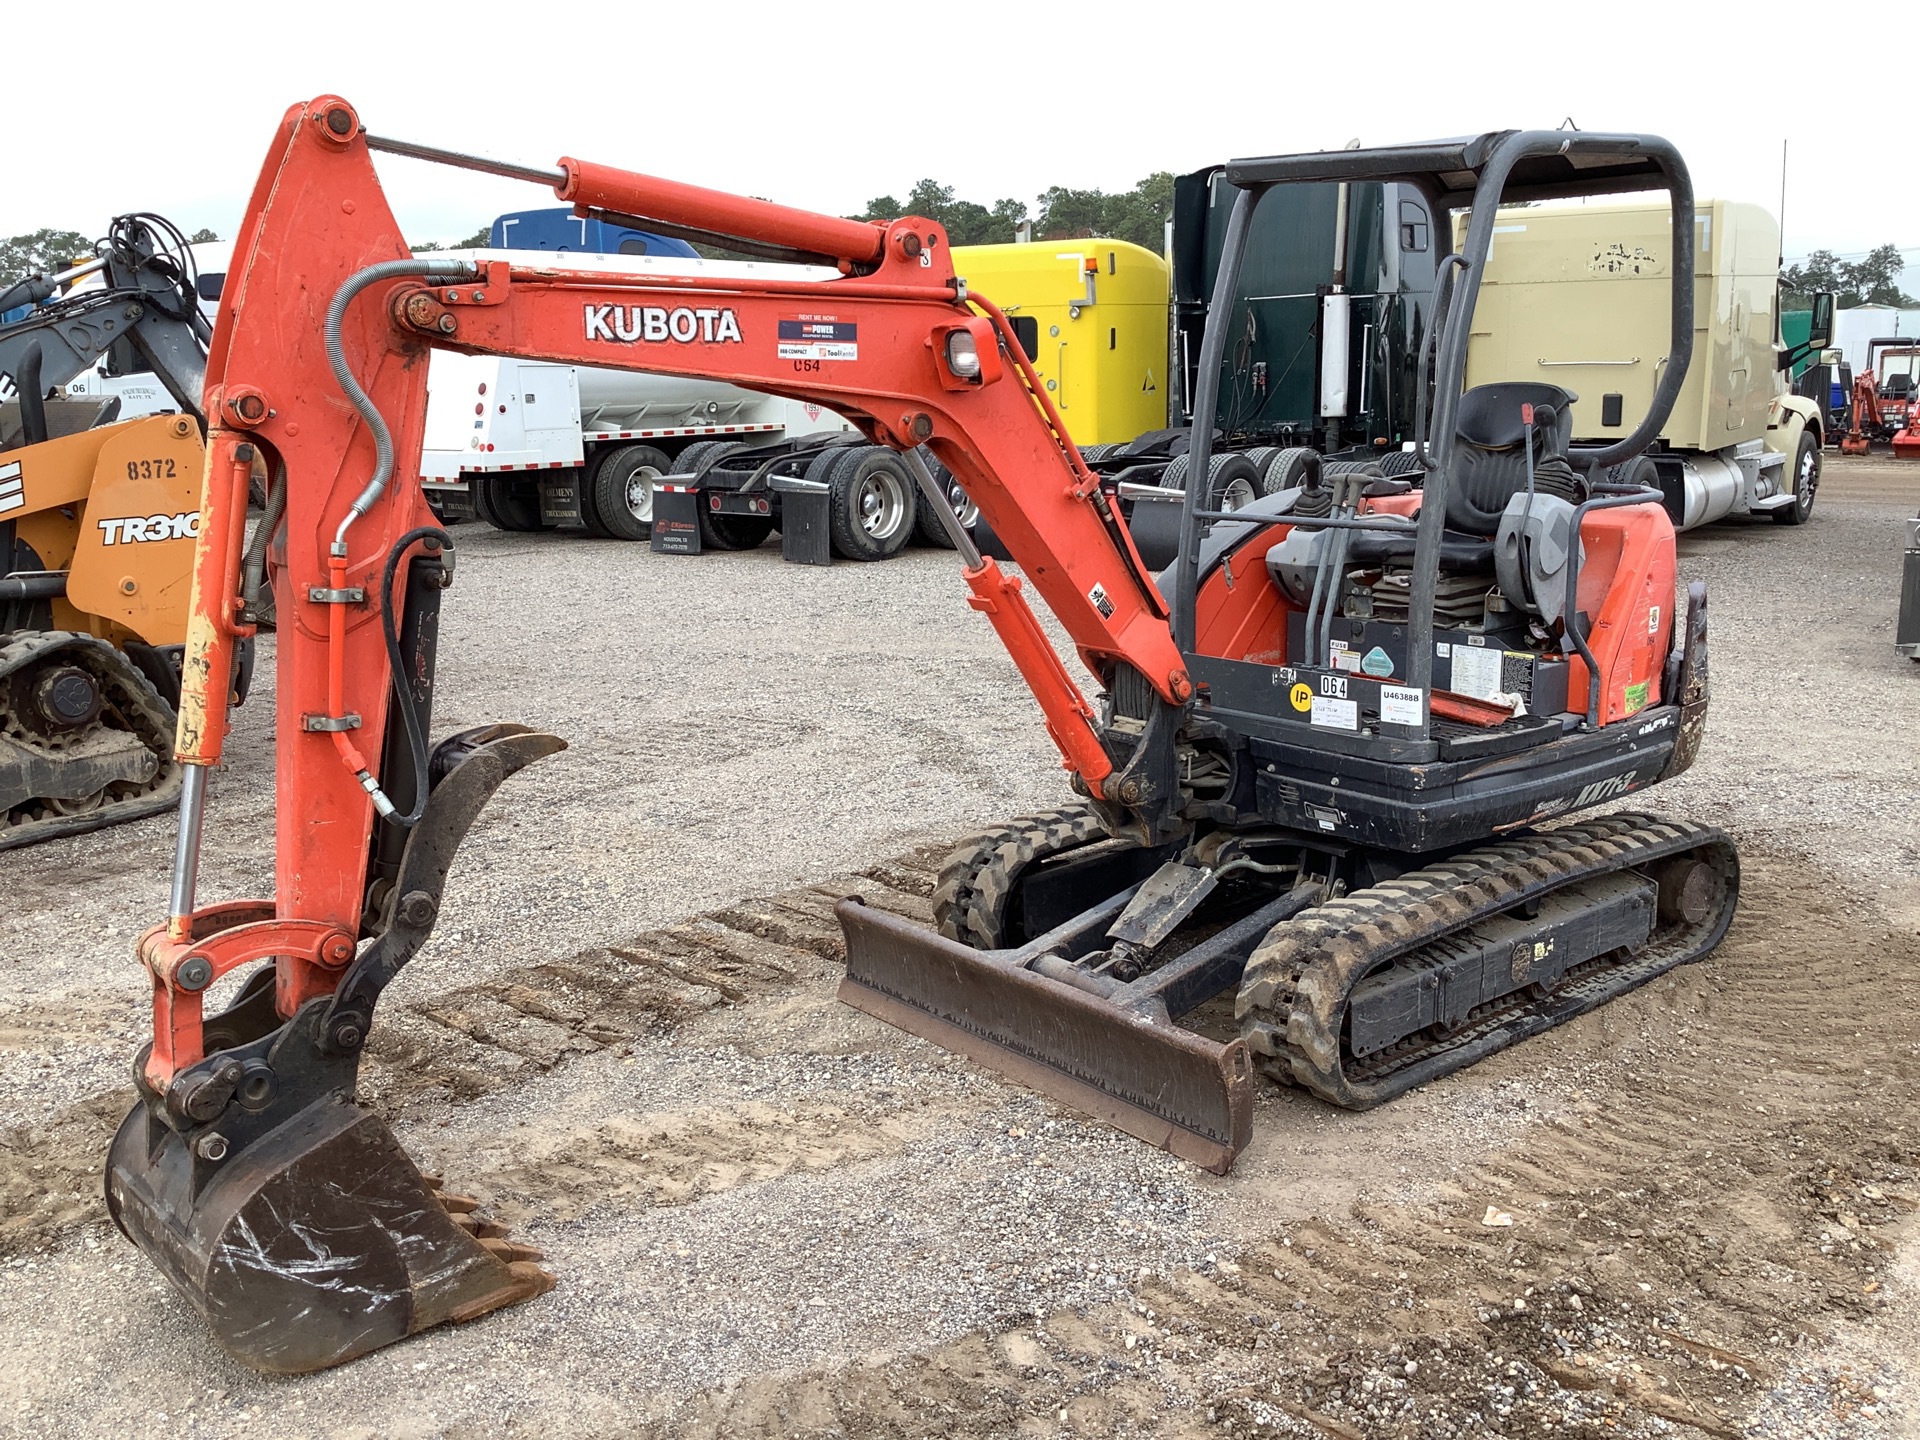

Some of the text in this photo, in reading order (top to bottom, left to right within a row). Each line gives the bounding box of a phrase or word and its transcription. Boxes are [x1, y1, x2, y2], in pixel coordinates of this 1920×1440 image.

[584, 304, 744, 343] KUBOTA
[812, 325, 834, 334] POWER
[72, 384, 86, 393] 06
[127, 459, 176, 480] 8372
[1331, 641, 1347, 649] FUSE
[1322, 677, 1346, 697] 064
[1295, 690, 1309, 704] IP
